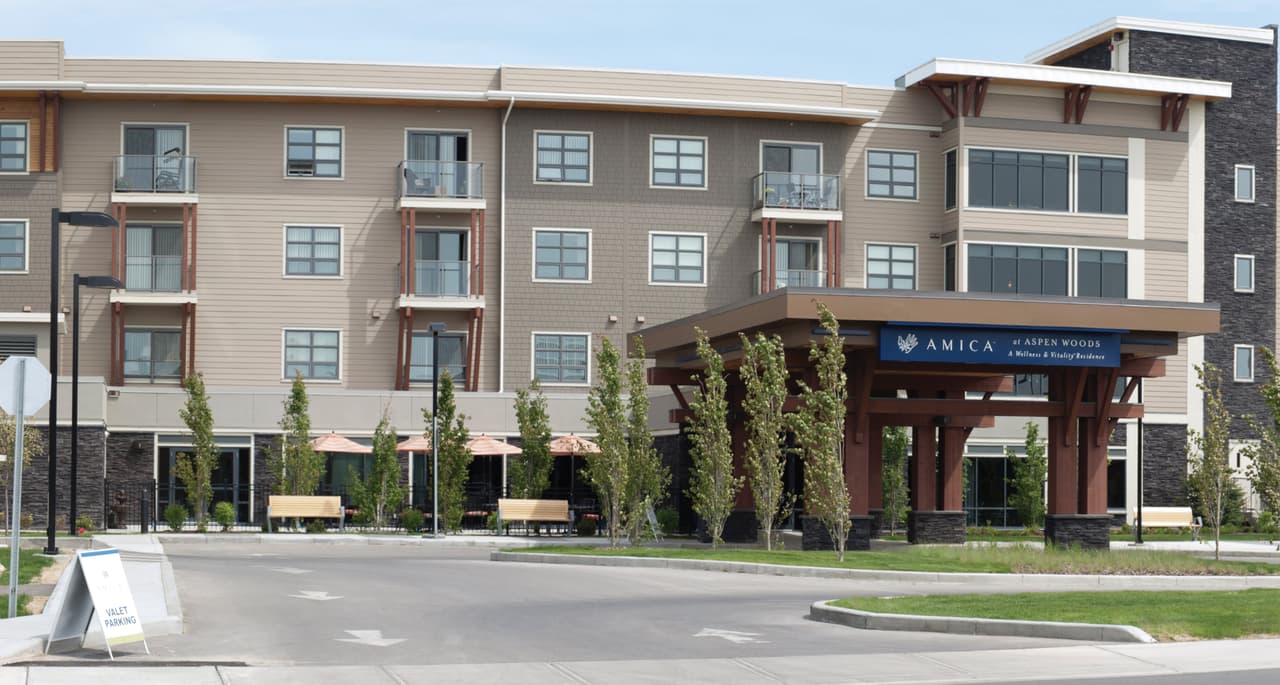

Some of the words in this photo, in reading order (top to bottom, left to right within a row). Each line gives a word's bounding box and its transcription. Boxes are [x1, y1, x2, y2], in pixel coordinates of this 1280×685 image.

[926, 338, 993, 352] AMICA
[1024, 338, 1058, 346] ASPEN
[1062, 339, 1101, 348] WOODS
[1015, 350, 1041, 358] Wellness
[1075, 352, 1105, 360] Residence
[105, 606, 128, 616] VALET
[104, 616, 136, 627] PARKING
